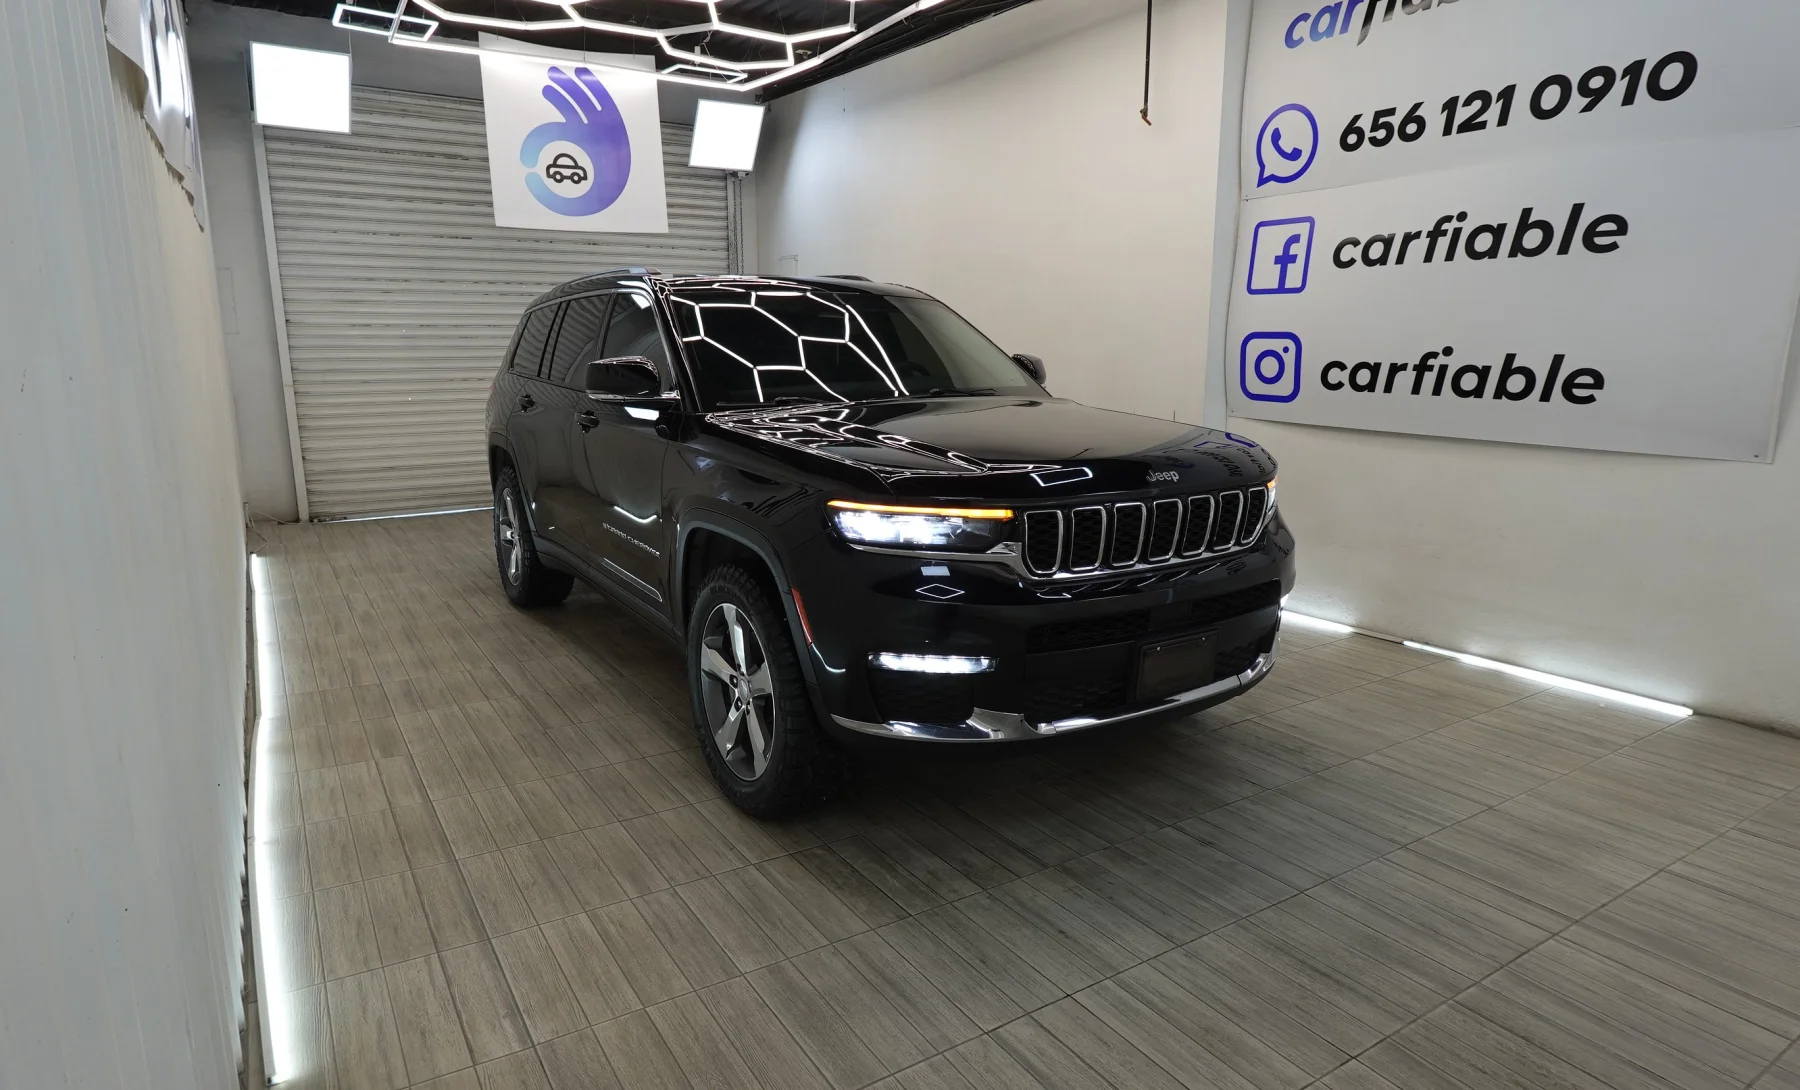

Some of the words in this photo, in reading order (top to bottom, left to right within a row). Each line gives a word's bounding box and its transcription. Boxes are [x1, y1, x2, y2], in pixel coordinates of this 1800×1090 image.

[1339, 101, 1427, 153] 656
[1440, 84, 1517, 137] 121
[1529, 50, 1699, 121] 0910
[1332, 202, 1630, 270] carfiable
[1320, 345, 1606, 405] carfiable
[1146, 469, 1180, 483] Jeep
